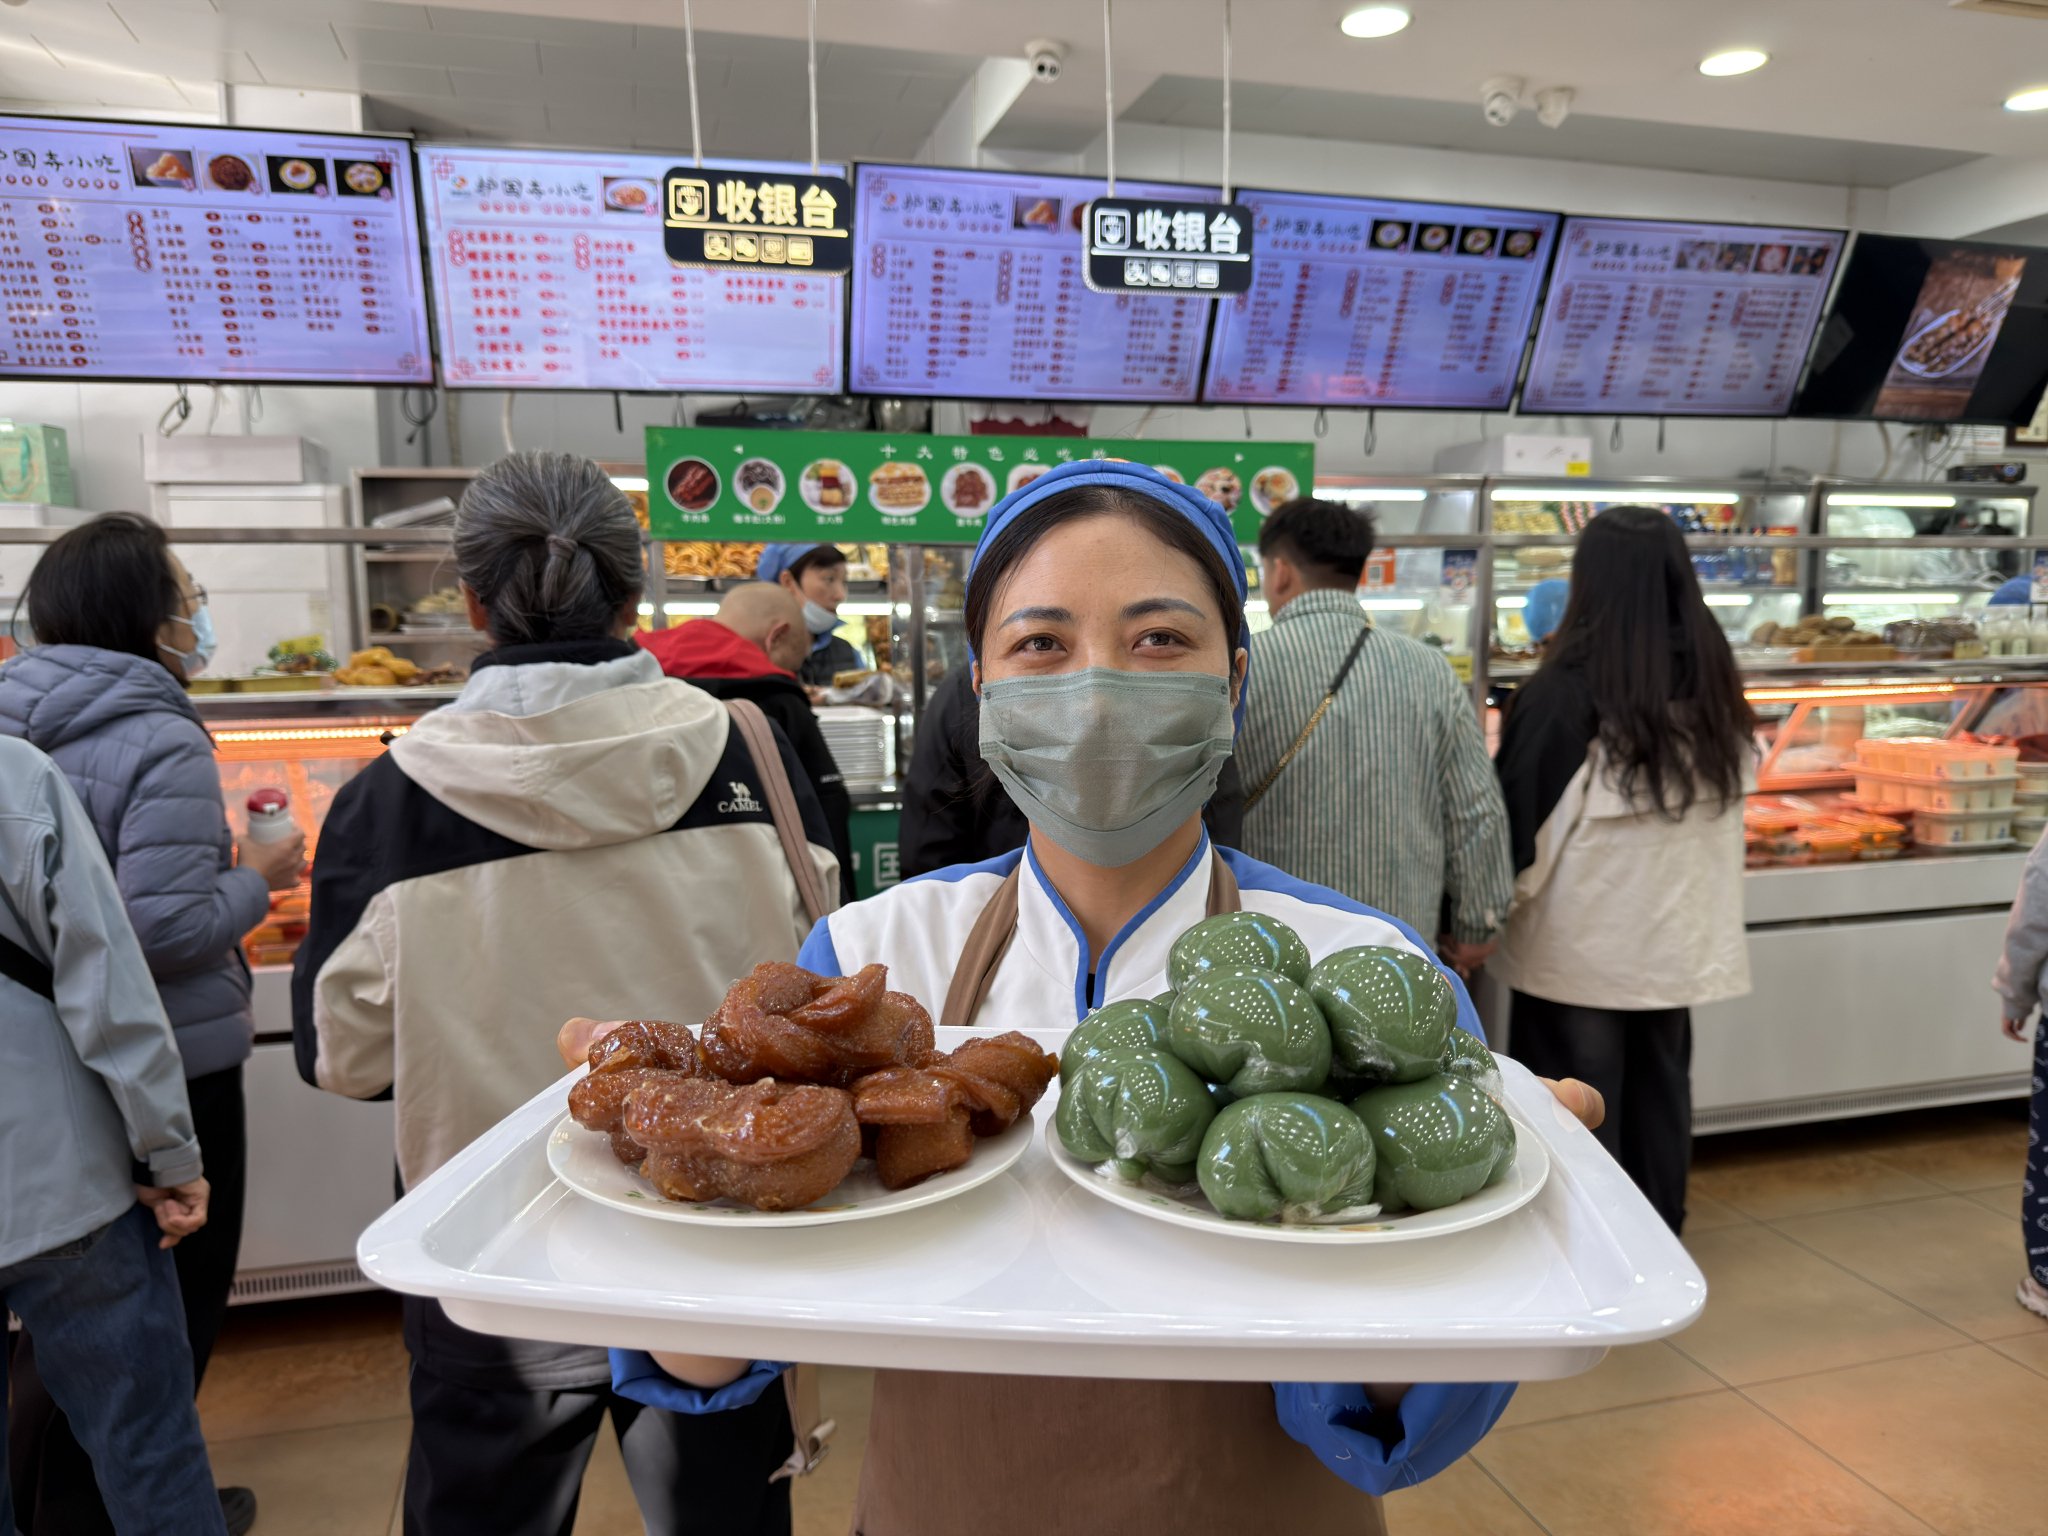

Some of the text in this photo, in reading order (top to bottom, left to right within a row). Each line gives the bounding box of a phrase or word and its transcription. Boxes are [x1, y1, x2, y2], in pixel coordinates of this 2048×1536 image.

[0, 147, 121, 174] 国寺小吃
[717, 179, 838, 229] 收银台
[1136, 208, 1242, 254] 收银台
[718, 801, 763, 813] CAMEL
